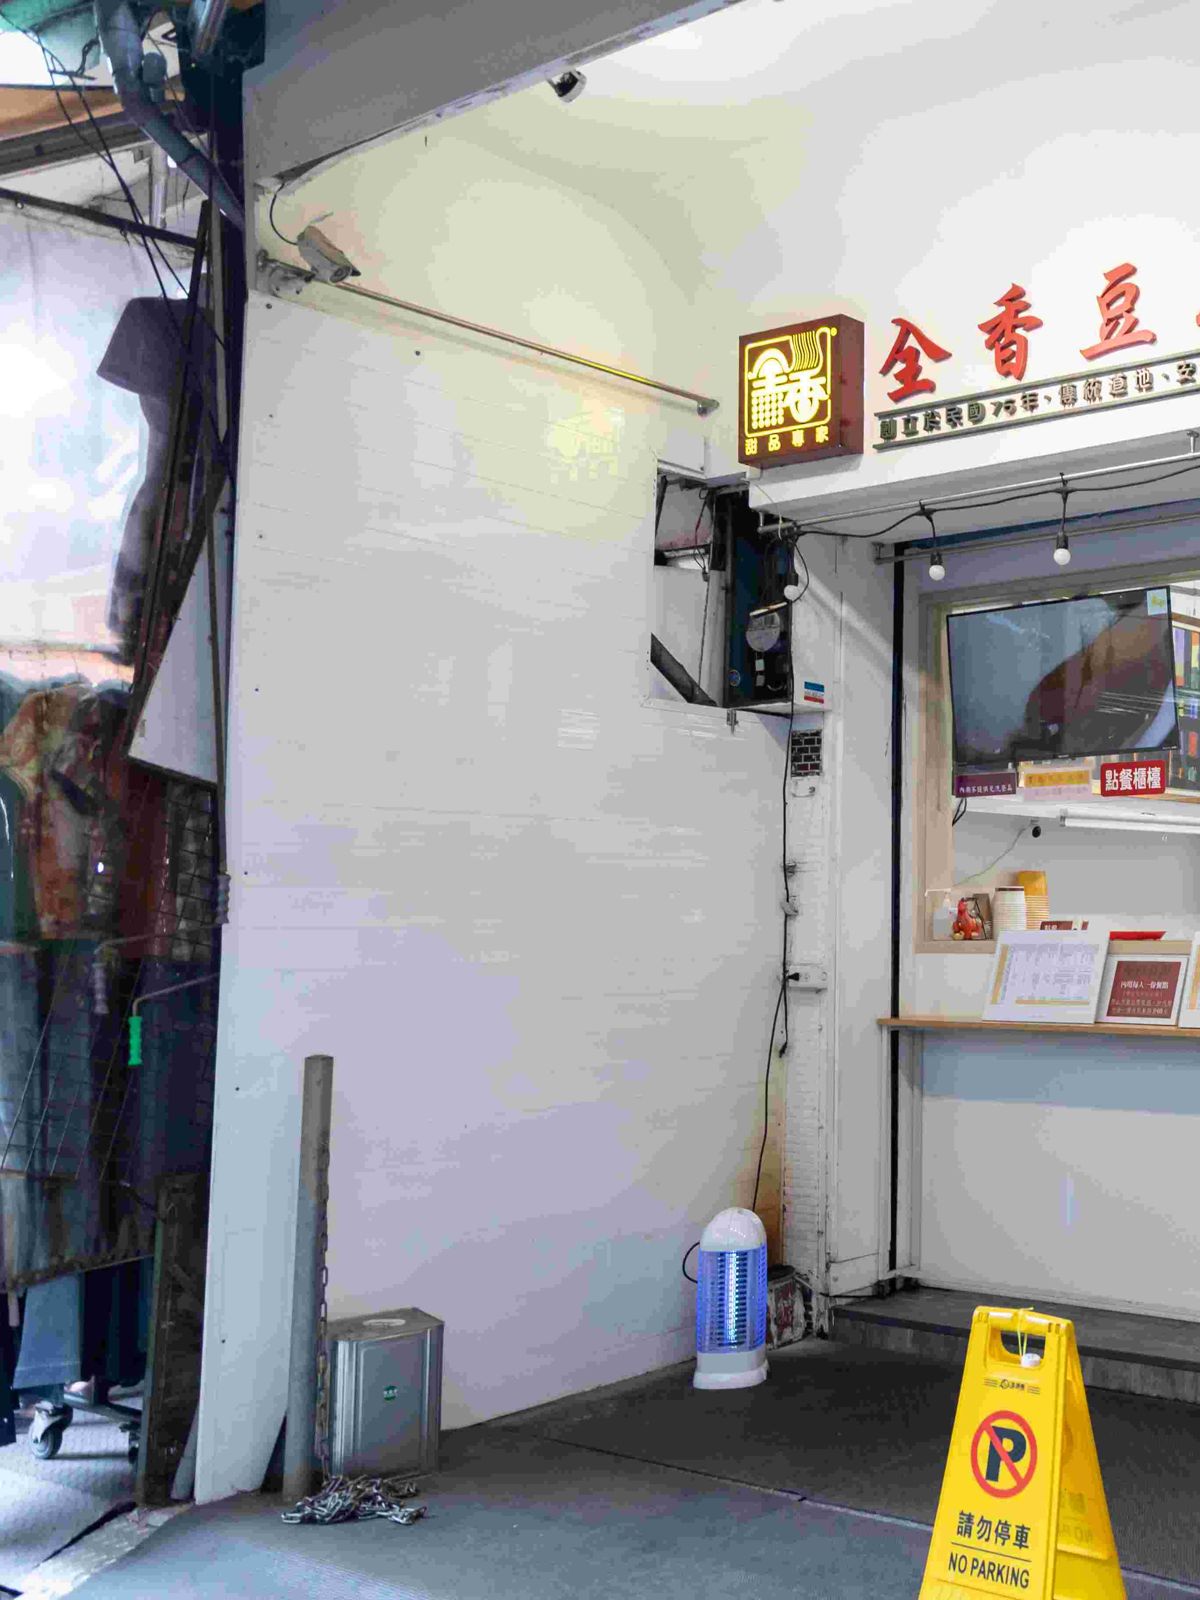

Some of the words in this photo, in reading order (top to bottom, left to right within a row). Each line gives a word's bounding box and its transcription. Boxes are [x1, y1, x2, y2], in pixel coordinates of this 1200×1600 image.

[1105, 766, 1161, 791] 點餐櫃檯
[956, 1510, 1031, 1550] 請勿停車
[948, 1552, 968, 1574] NO
[970, 1556, 1030, 1590] PARKING
